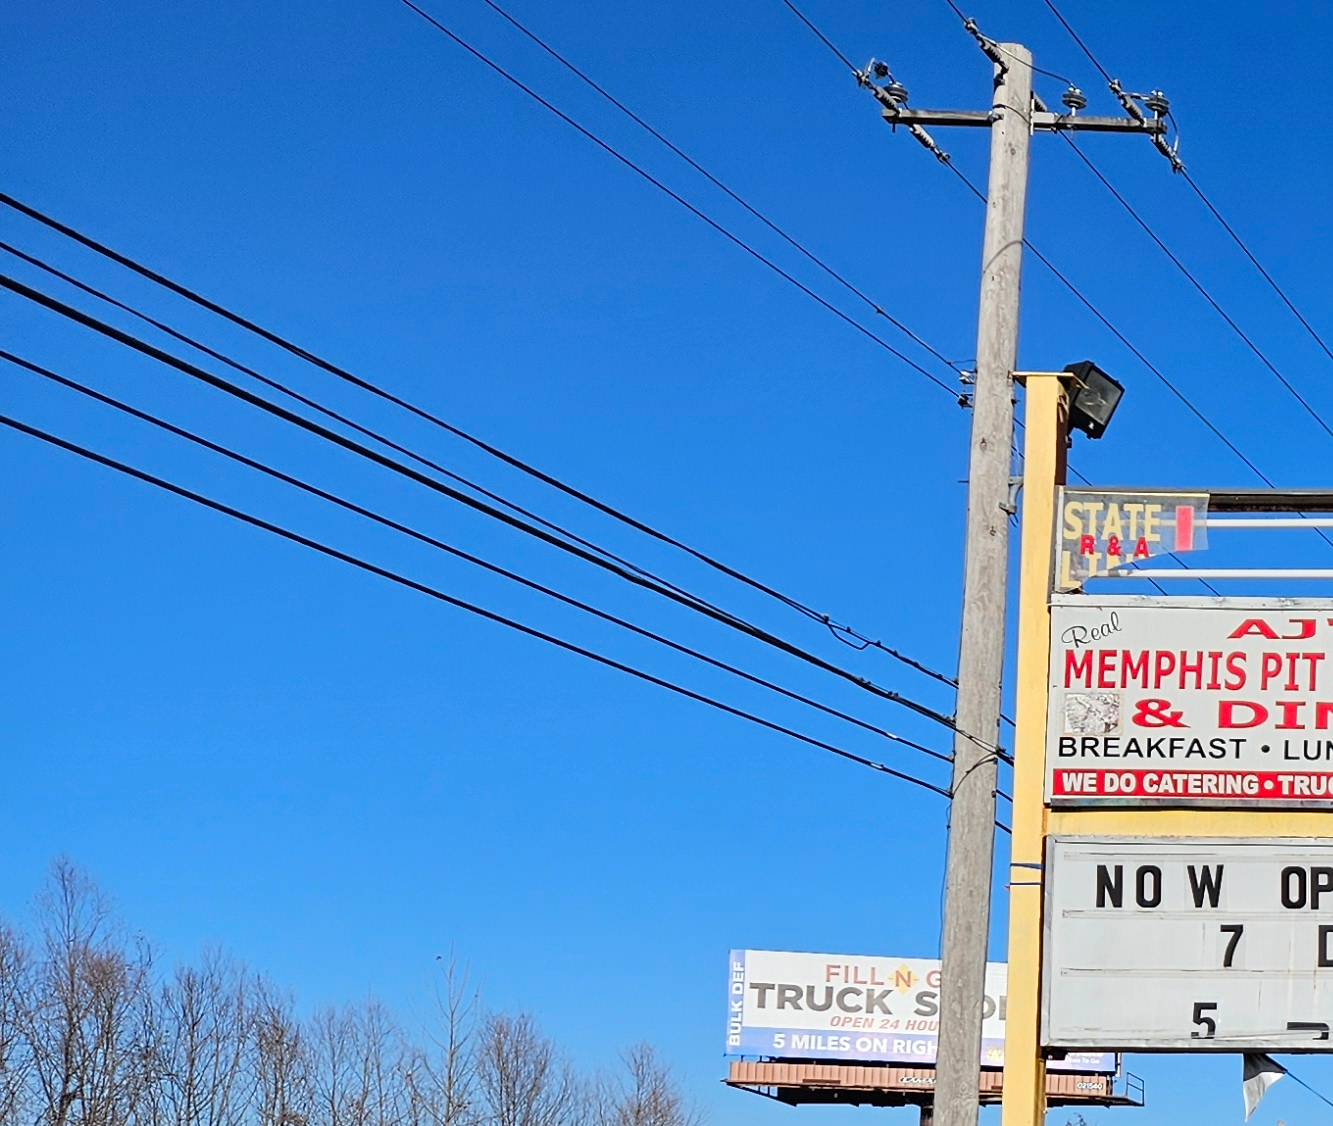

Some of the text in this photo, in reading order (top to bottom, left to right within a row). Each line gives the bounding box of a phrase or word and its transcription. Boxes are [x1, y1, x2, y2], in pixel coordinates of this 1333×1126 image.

[1062, 501, 1161, 541] STATE
[1080, 534, 1149, 557] R & A
[1061, 612, 1122, 648] Real
[1064, 649, 1247, 690] MEMPHIS
[1260, 652, 1325, 691] PIT
[1132, 699, 1191, 728] &
[1058, 737, 1247, 758] BREAKFAST
[1062, 772, 1097, 792] WE
[1104, 773, 1136, 793] DO
[1142, 773, 1259, 795] CATERING
[1220, 923, 1244, 968] 7
[826, 964, 941, 988] FILL N G
[728, 961, 745, 1046] BULK DEF
[749, 982, 893, 1015] TRUCK
[830, 1015, 940, 1031] OPEN 24 HOU
[773, 1033, 938, 1055] 5 MILES ON RIGH
